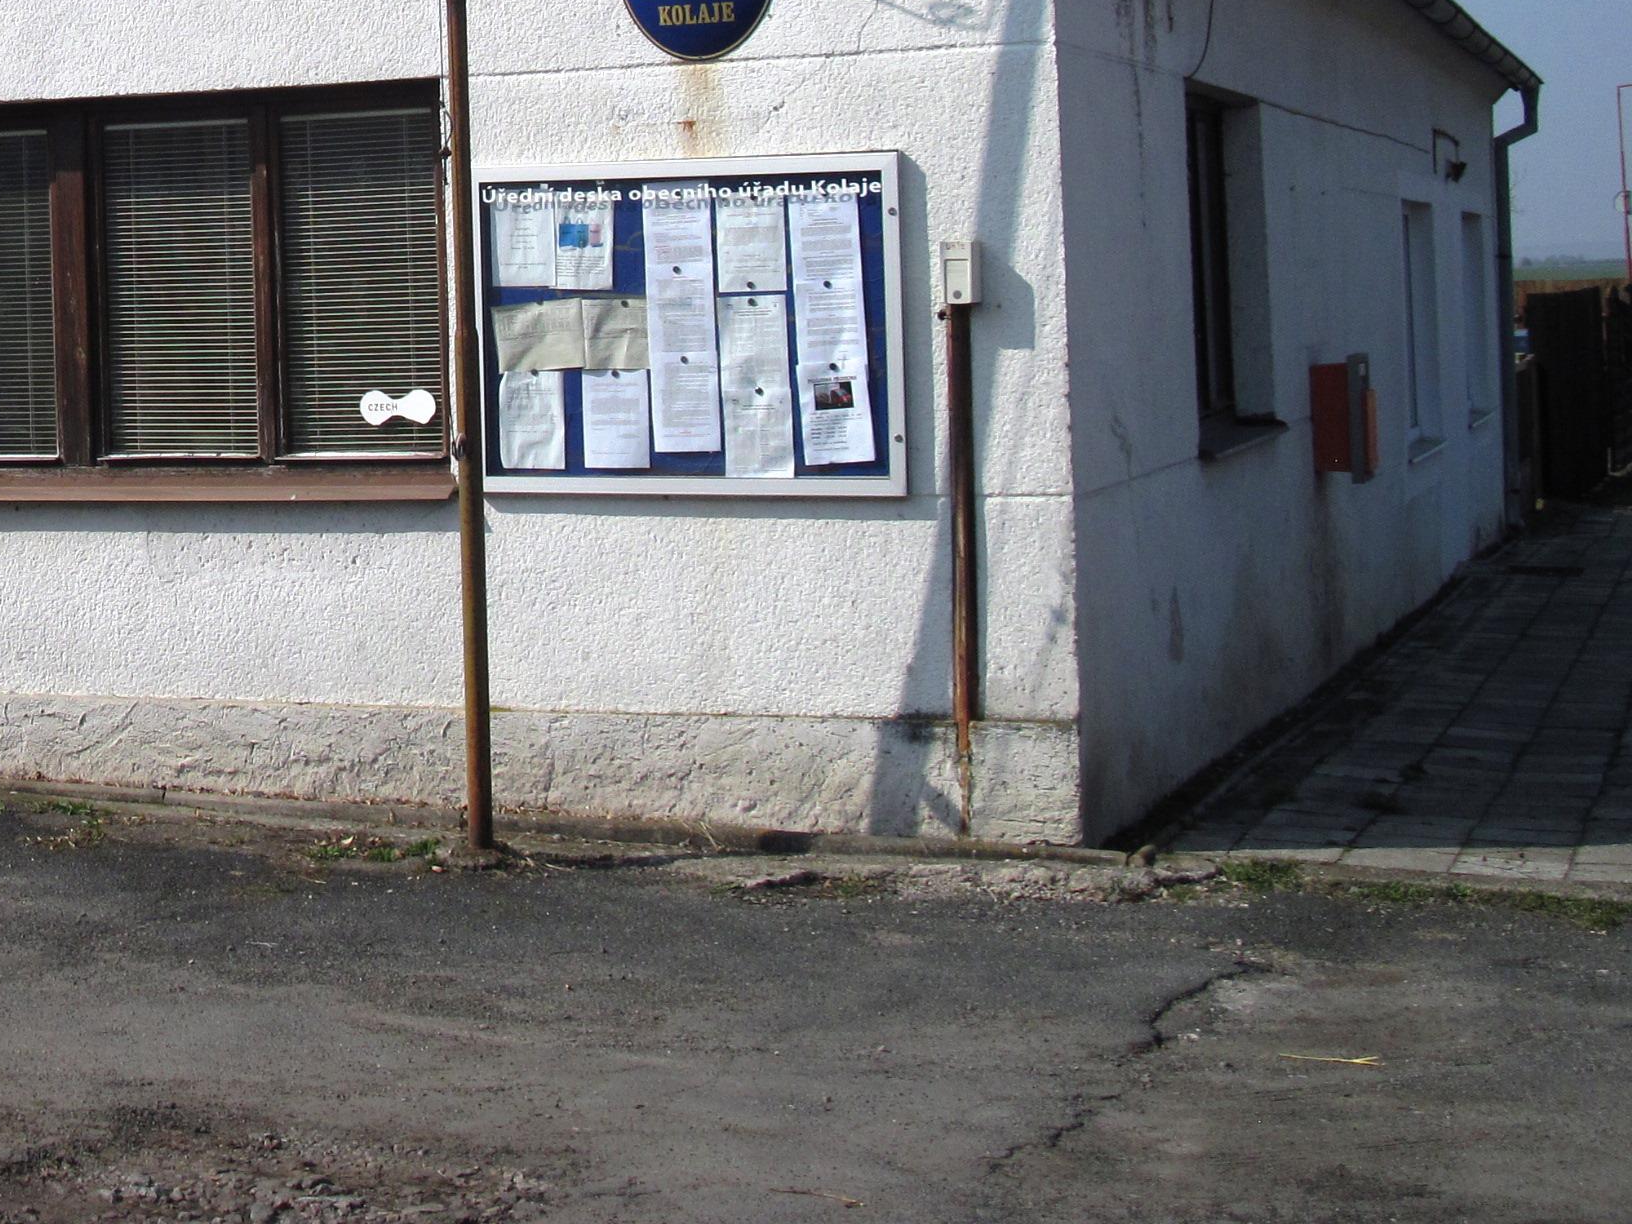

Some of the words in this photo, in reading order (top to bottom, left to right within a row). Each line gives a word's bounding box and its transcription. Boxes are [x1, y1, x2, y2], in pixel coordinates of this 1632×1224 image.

[657, 1, 735, 26] KOLAJE
[482, 186, 554, 203] Úřední
[559, 186, 622, 202] deska
[628, 182, 731, 201] obecního
[738, 180, 804, 197] úřadu
[811, 178, 882, 197] Kolaje
[368, 403, 398, 412] CZECH
